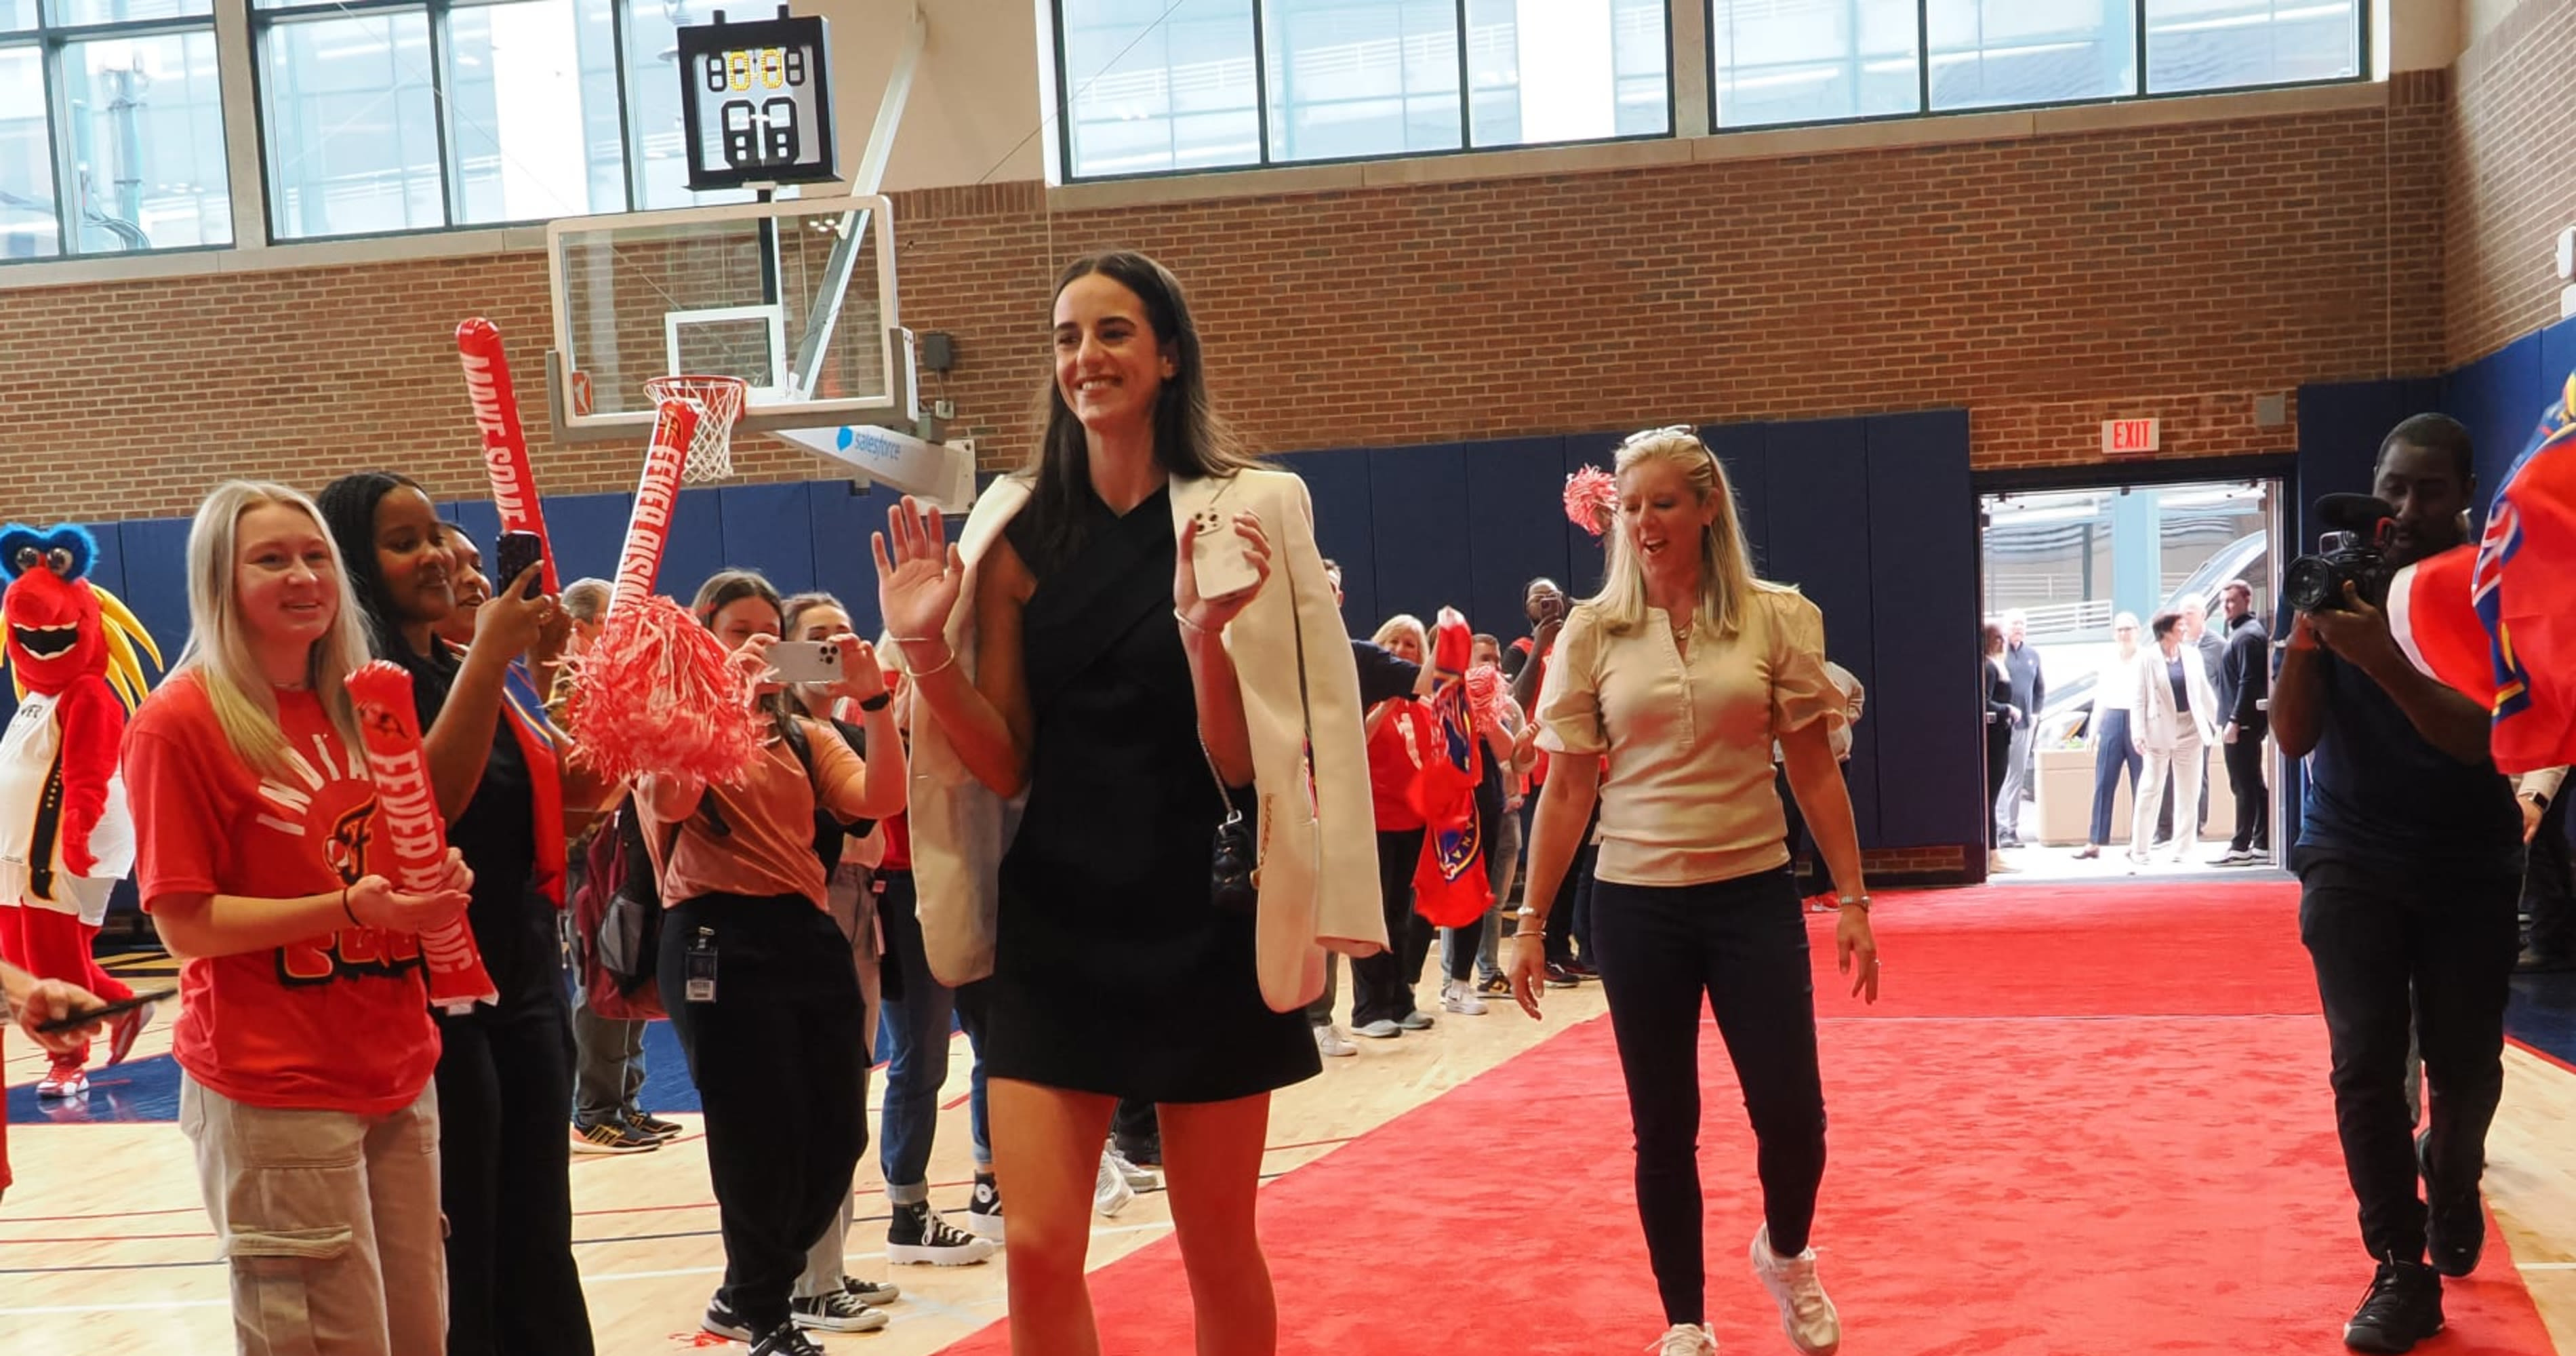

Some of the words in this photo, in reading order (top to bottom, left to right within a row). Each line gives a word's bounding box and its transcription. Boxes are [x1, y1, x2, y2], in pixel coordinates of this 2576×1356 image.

[459, 351, 506, 437] MAKE
[485, 446, 527, 523] SOME
[855, 431, 901, 461] salesforce
[2113, 420, 2150, 449] EXIT
[633, 443, 681, 528] FEVER
[613, 527, 662, 612] RISIN
[256, 730, 369, 837] INDIA
[368, 749, 439, 859] FEVER
